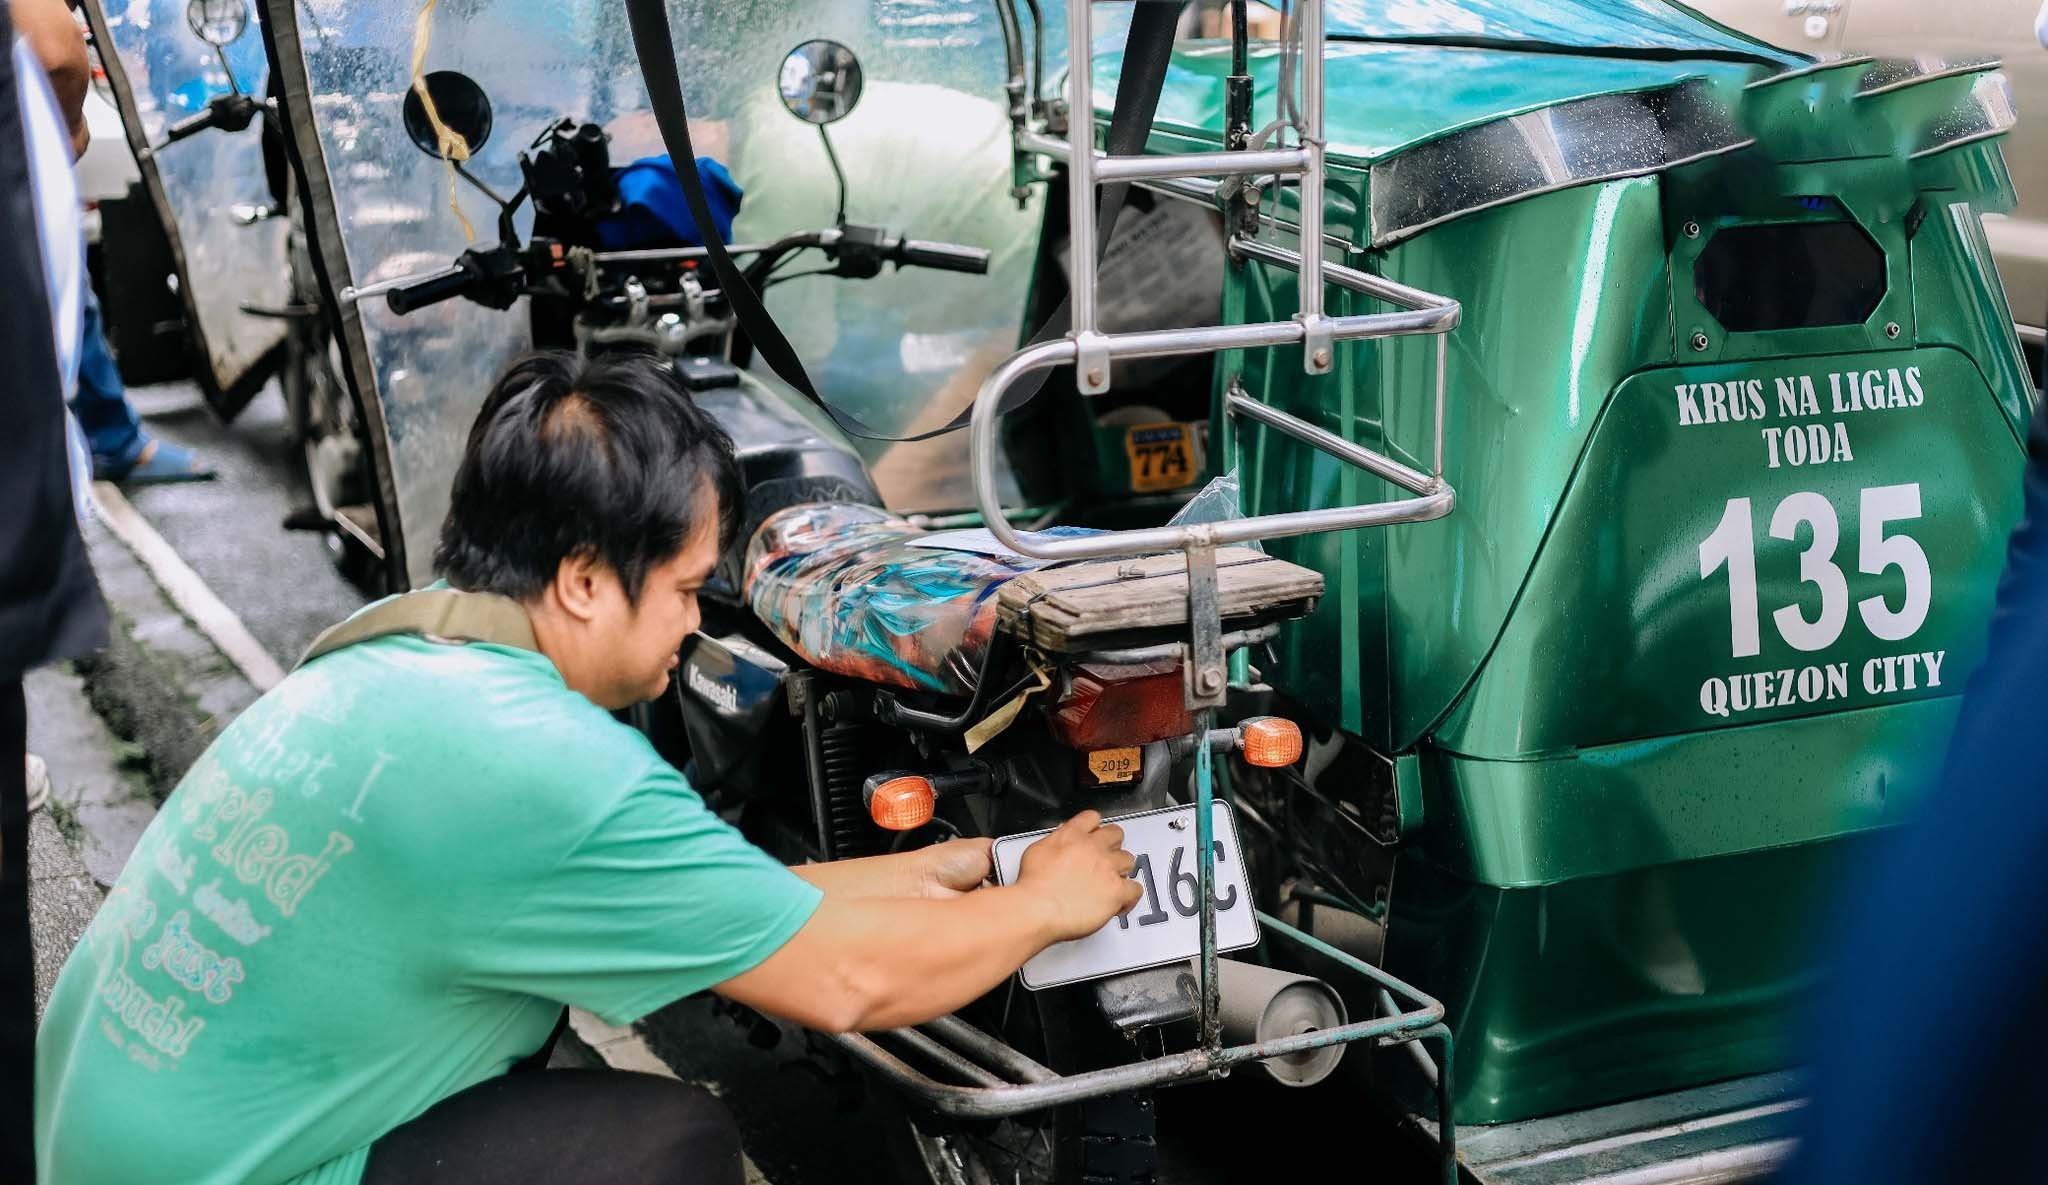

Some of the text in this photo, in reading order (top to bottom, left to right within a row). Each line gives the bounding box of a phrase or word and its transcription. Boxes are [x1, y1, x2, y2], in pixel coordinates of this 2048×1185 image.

[1674, 366, 1925, 426] KRUS NA LIGAS
[1762, 422, 1853, 468] TODA
[1699, 483, 1931, 658] 135
[689, 663, 737, 713] Kawasaki
[1700, 650, 1945, 717] QUEZON CITY
[1117, 840, 1237, 930] 16C
